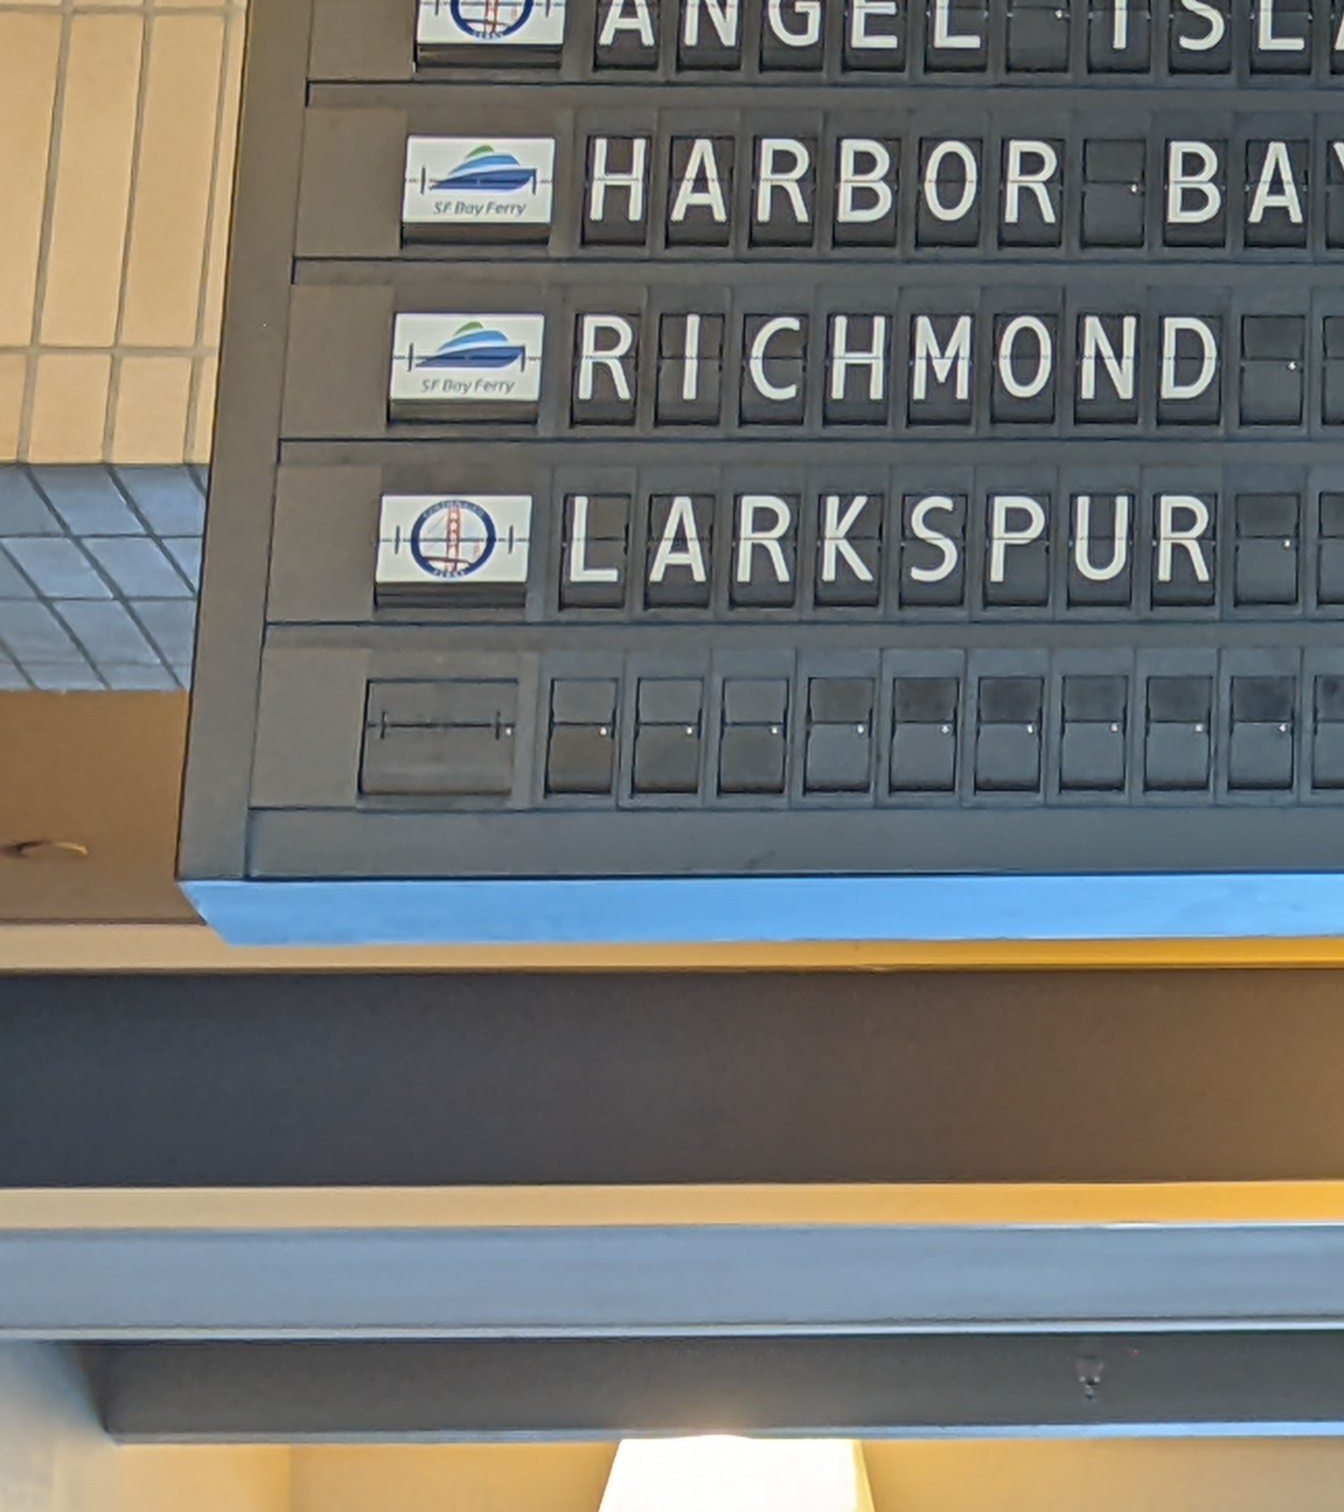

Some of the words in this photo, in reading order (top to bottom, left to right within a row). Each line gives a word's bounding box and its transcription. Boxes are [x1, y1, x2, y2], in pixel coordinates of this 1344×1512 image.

[433, 201, 452, 215] SF
[454, 201, 484, 218] Bay
[485, 201, 527, 216] Ferry
[588, 137, 1058, 224] HARBOR
[421, 379, 441, 393] SF
[443, 379, 472, 395] Bay
[473, 378, 516, 394] Ferry
[577, 312, 1218, 402] RICHMOND
[568, 493, 1211, 584] LARKSPUR
